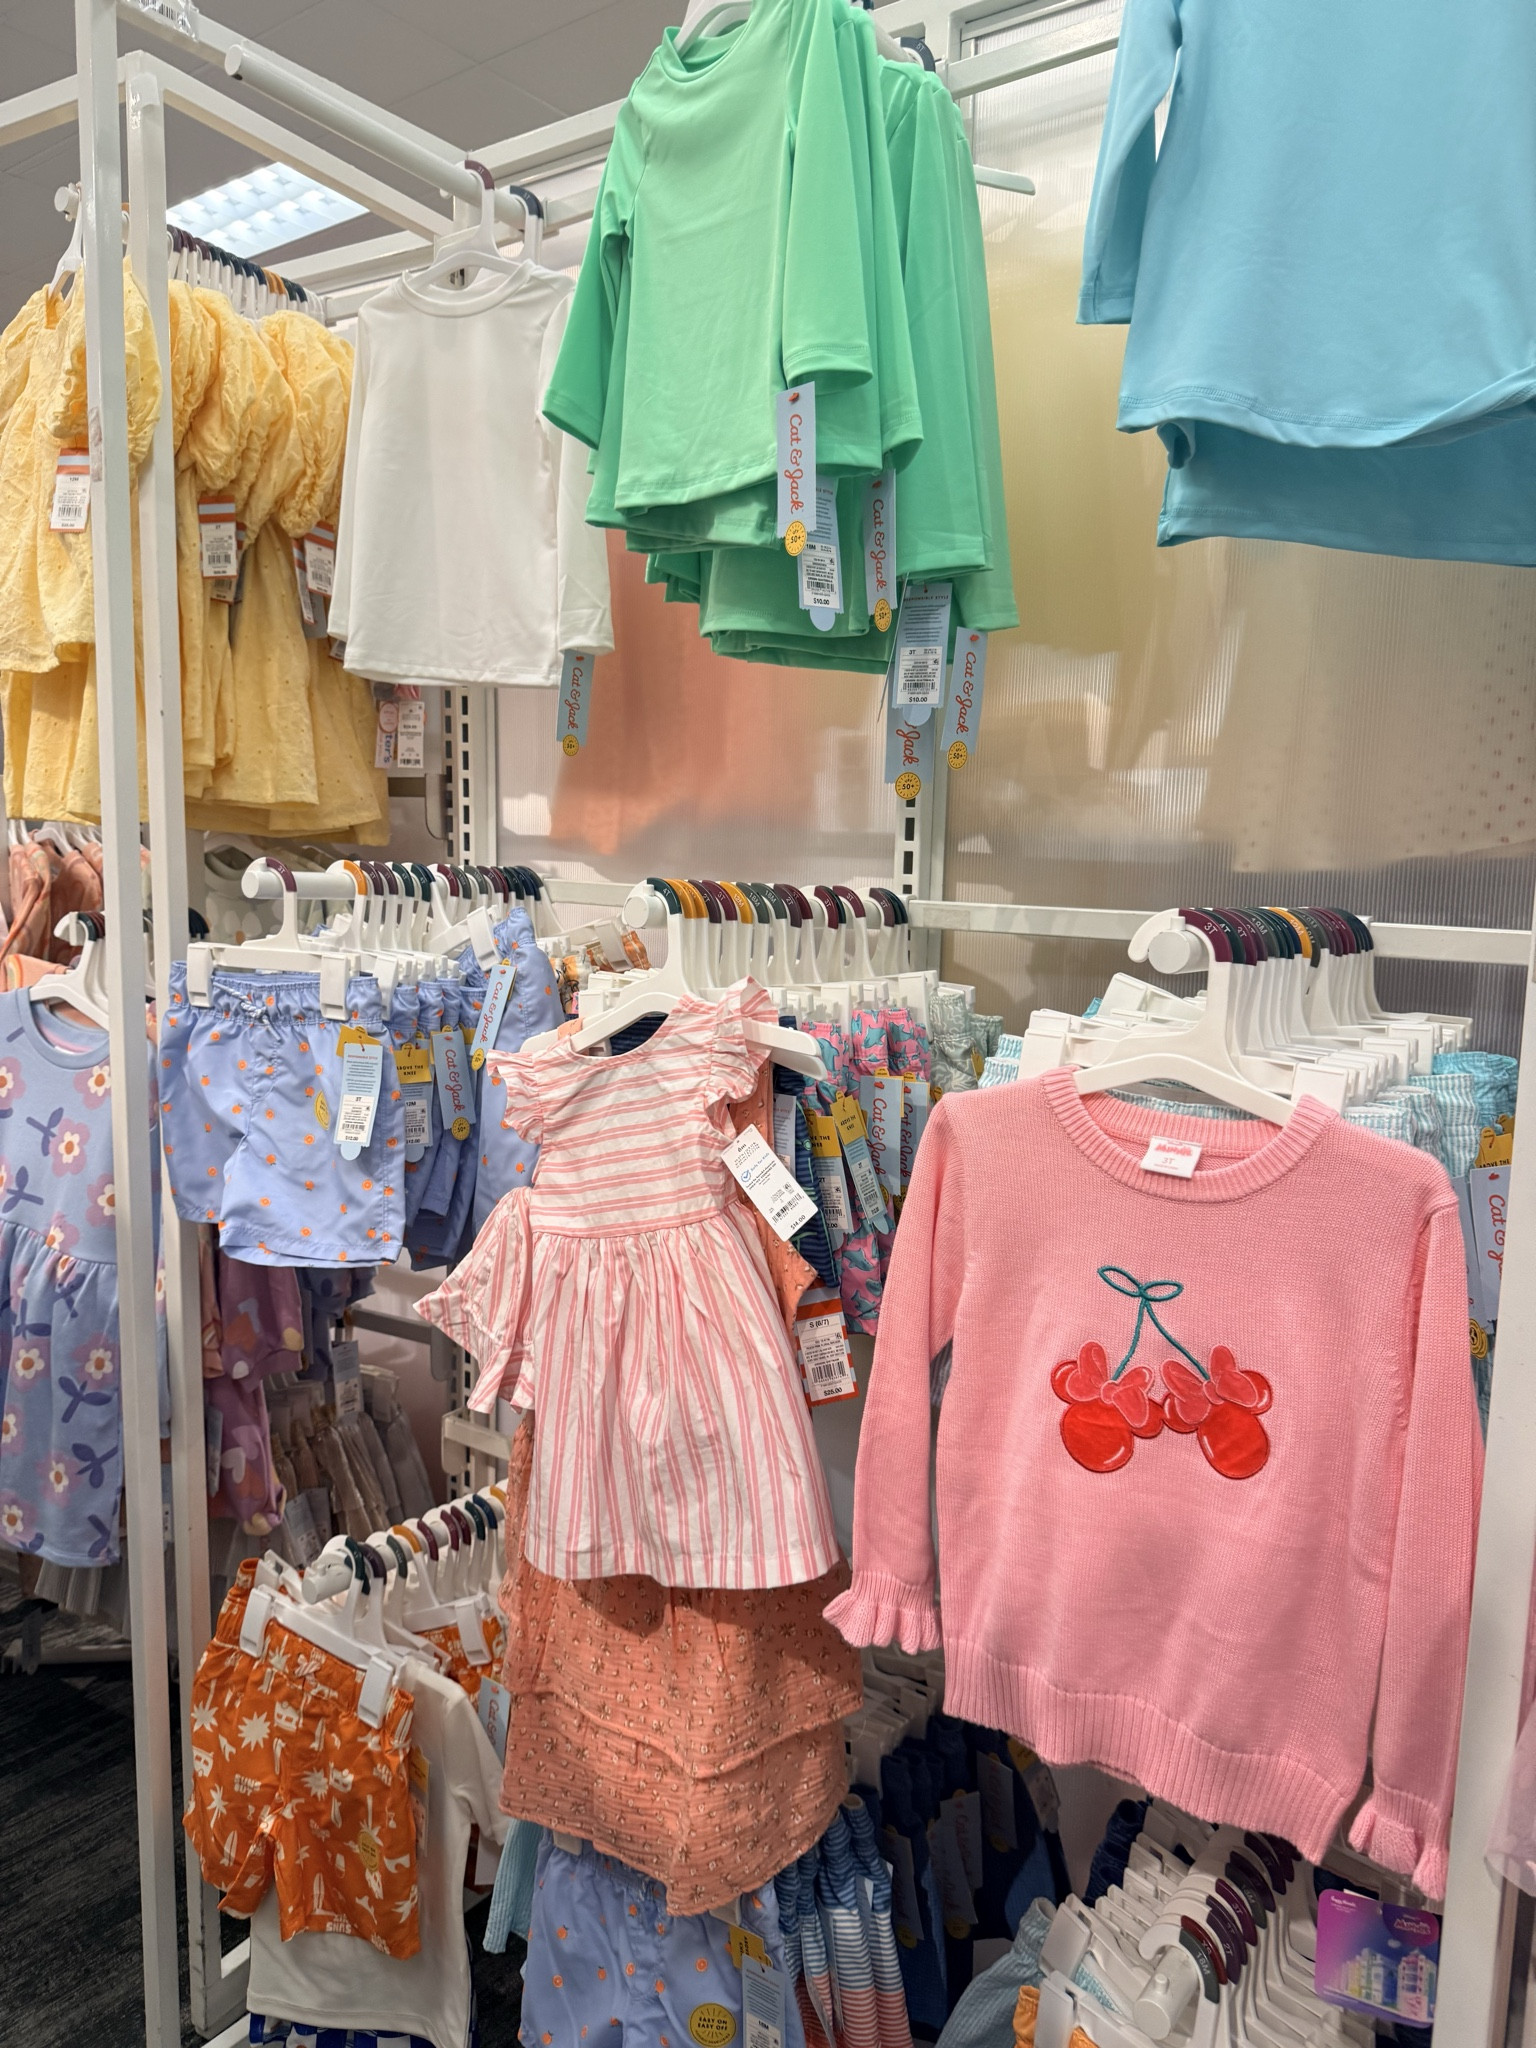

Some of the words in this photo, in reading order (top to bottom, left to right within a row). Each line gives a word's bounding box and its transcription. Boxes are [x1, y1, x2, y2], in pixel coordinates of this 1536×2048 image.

[789, 413, 803, 446] Cat
[789, 448, 803, 465] &
[784, 468, 804, 514] Jack
[873, 499, 885, 529] Cat
[790, 535, 801, 544] 50+
[874, 531, 886, 547] &
[870, 550, 887, 593] Jack
[813, 597, 830, 605] $10.00
[878, 611, 887, 619] 50+
[964, 651, 977, 678] Cat
[571, 667, 583, 687] Cat
[570, 688, 581, 701] &
[962, 680, 974, 696] &
[564, 699, 580, 730] Jack
[955, 694, 973, 735] Jack
[896, 728, 920, 767] Jack
[953, 752, 963, 760] 50+
[663, 888, 671, 897] 4T
[703, 893, 711, 903] 2T
[718, 891, 726, 901] 3T
[733, 894, 745, 907] 12M
[749, 892, 760, 907] 18M
[765, 890, 777, 903] 18M
[786, 896, 794, 905] 2T
[846, 892, 855, 901] 3T
[1204, 922, 1218, 935] 3T
[492, 981, 503, 1001] Cat
[488, 1002, 496, 1015] &
[480, 1013, 494, 1043] Jack
[445, 1049, 457, 1070] Cat
[449, 1071, 459, 1083] &
[445, 1083, 465, 1114] Jack
[873, 1098, 887, 1123] Cat
[872, 1125, 885, 1142] &
[901, 1128, 912, 1145] &
[867, 1139, 886, 1175] Jack
[1162, 1157, 1175, 1165] 3T
[1488, 1194, 1506, 1227] Cat
[790, 1214, 806, 1230] $14.00
[815, 1319, 829, 1328] (6/7)
[823, 1387, 842, 1396] $25.00
[489, 1700, 499, 1721] Cat
[234, 1784, 252, 1796] OUT
[235, 1773, 262, 1791] SUNS
[326, 1921, 352, 1934] SUNS
[1224, 1943, 1233, 1956] 2T
[1196, 1951, 1211, 1975] 18M
